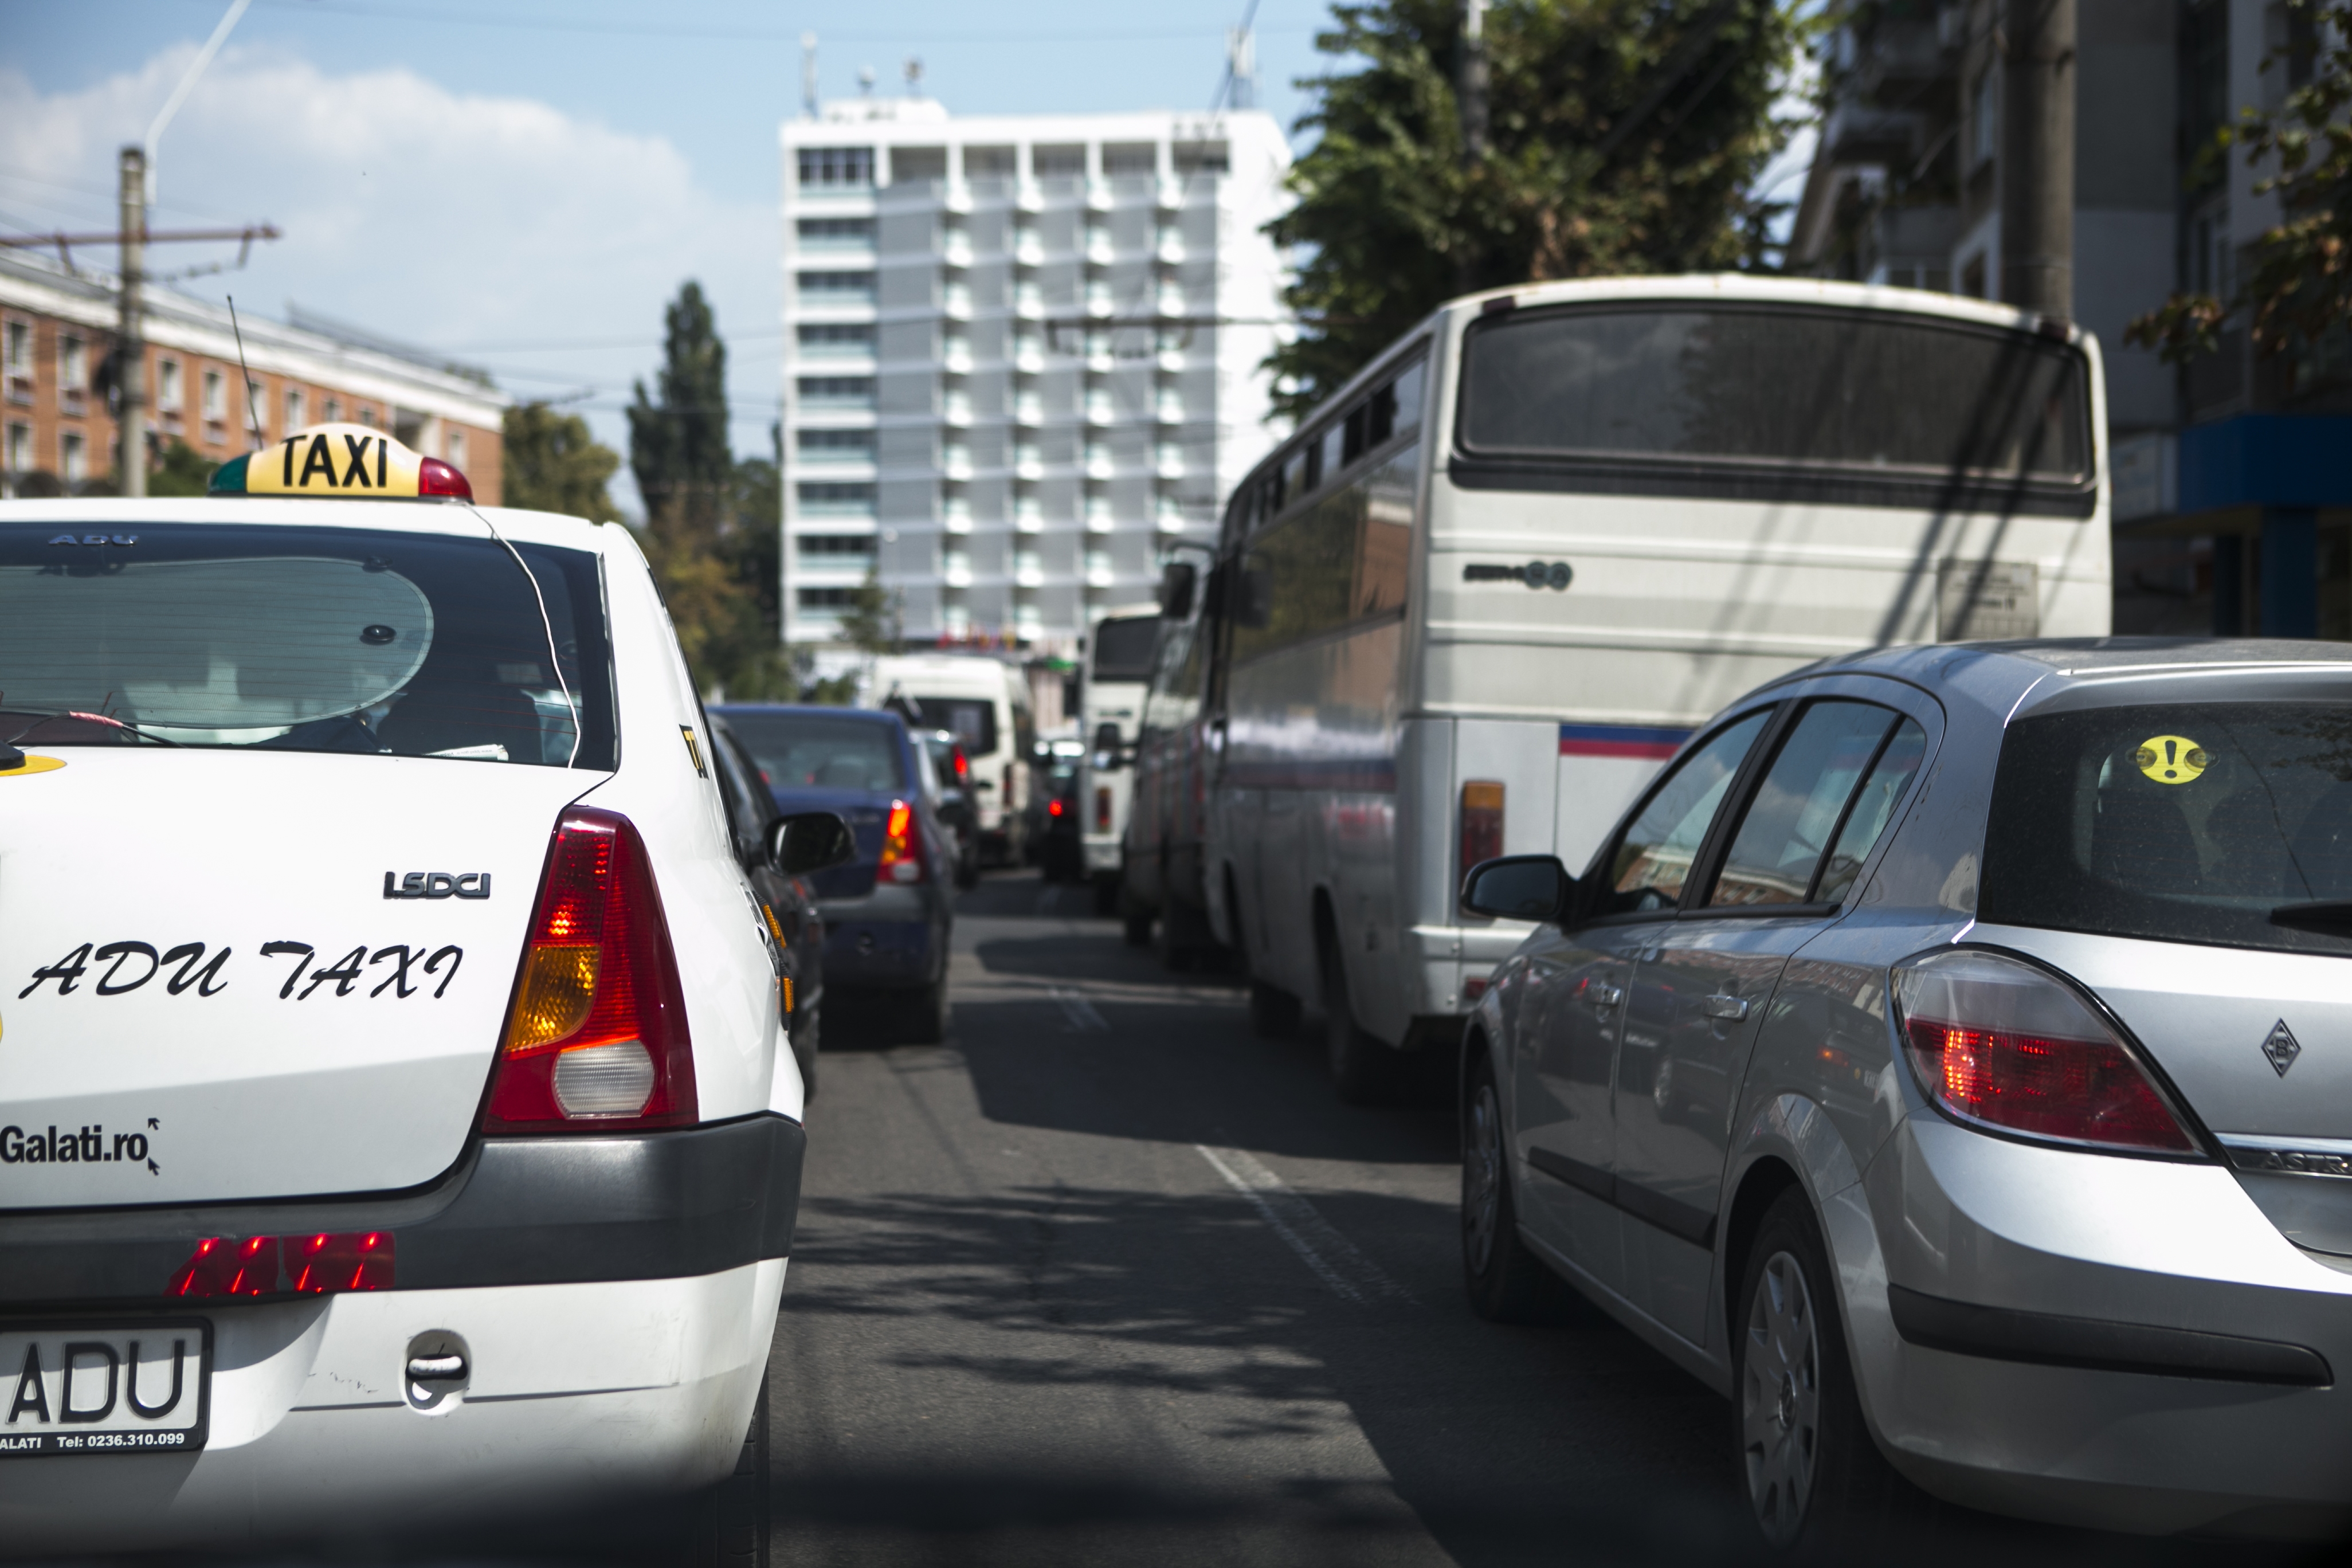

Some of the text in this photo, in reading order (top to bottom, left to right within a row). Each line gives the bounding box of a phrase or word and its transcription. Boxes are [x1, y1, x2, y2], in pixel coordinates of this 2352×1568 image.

[280, 434, 387, 488] TAXI
[48, 535, 139, 546] ADU
[18, 940, 463, 1001] ADU TAXI
[0, 1124, 148, 1163] Galati.ro
[2260, 1151, 2352, 1174] ASTR
[6, 1339, 186, 1424] ADU
[57, 1436, 84, 1448] Tel:
[87, 1433, 185, 1447] 0236.310.099
